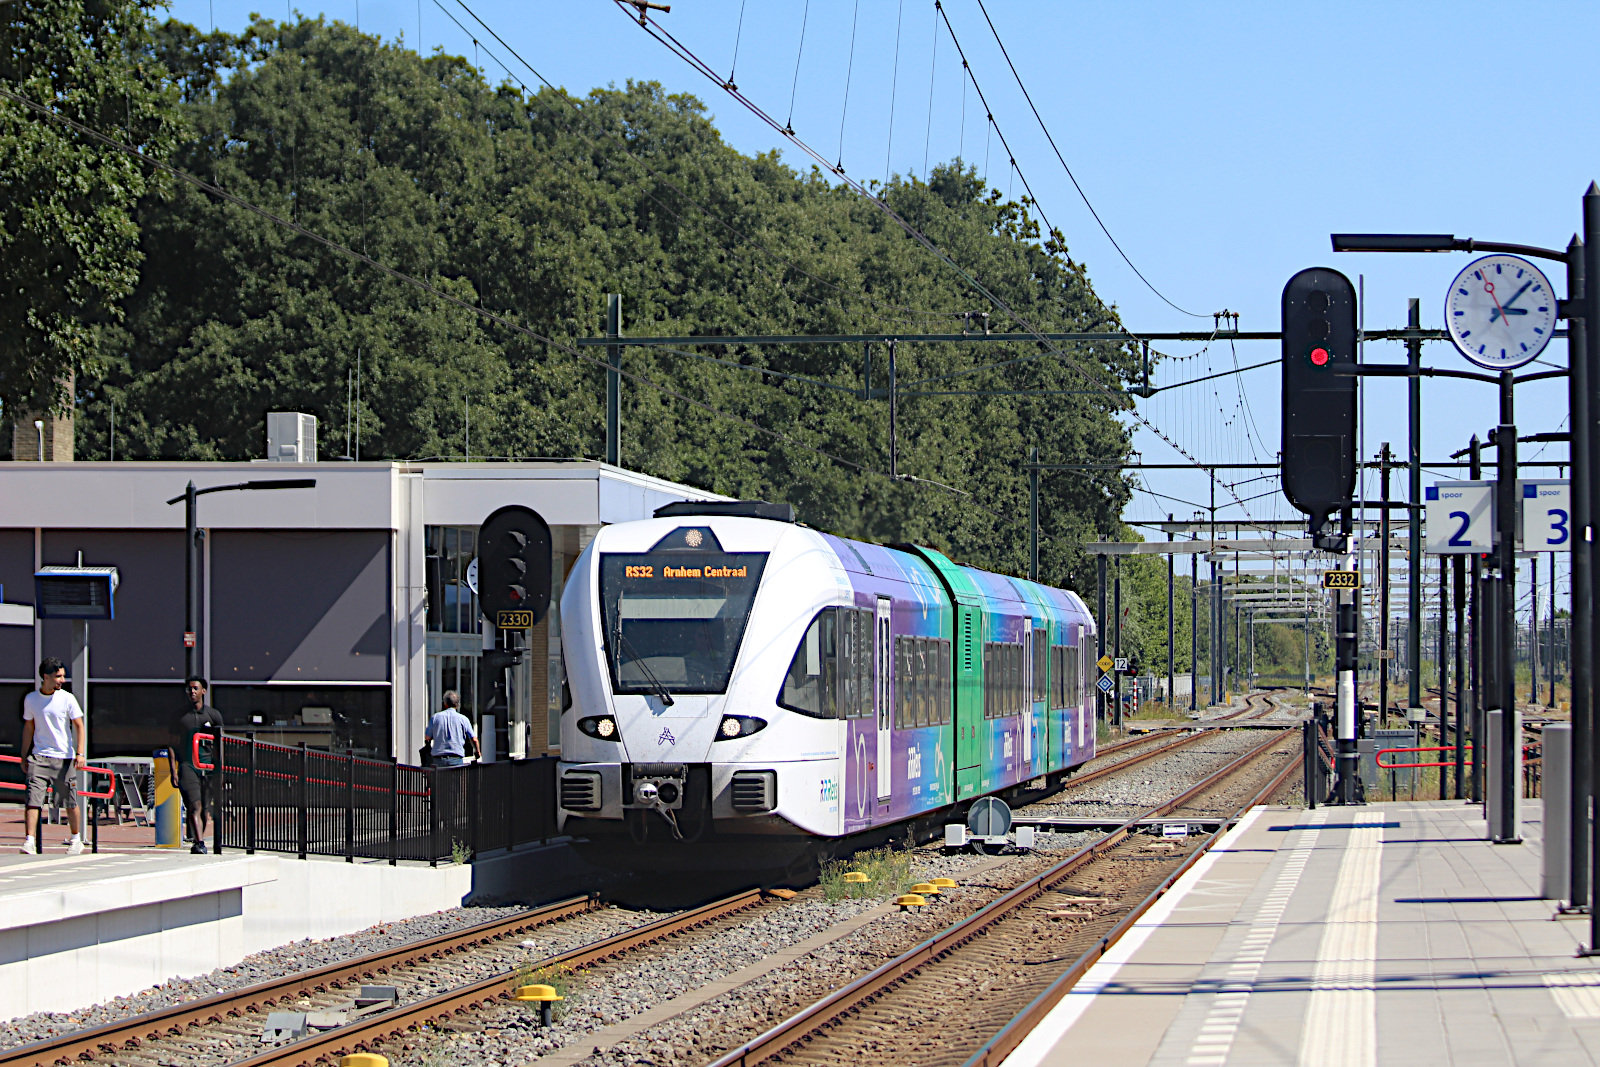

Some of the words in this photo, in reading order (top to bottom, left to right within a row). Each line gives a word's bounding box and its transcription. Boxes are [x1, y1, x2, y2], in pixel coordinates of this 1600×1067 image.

[1539, 489, 1561, 497] spoor
[1448, 511, 1472, 546] 2
[1547, 508, 1569, 545] 3
[625, 565, 654, 578] RS32
[663, 565, 701, 578] Arnhem
[704, 565, 747, 578] Centraal
[1328, 573, 1355, 586] 2332
[500, 613, 530, 625] 2330
[1116, 658, 1126, 669] 12
